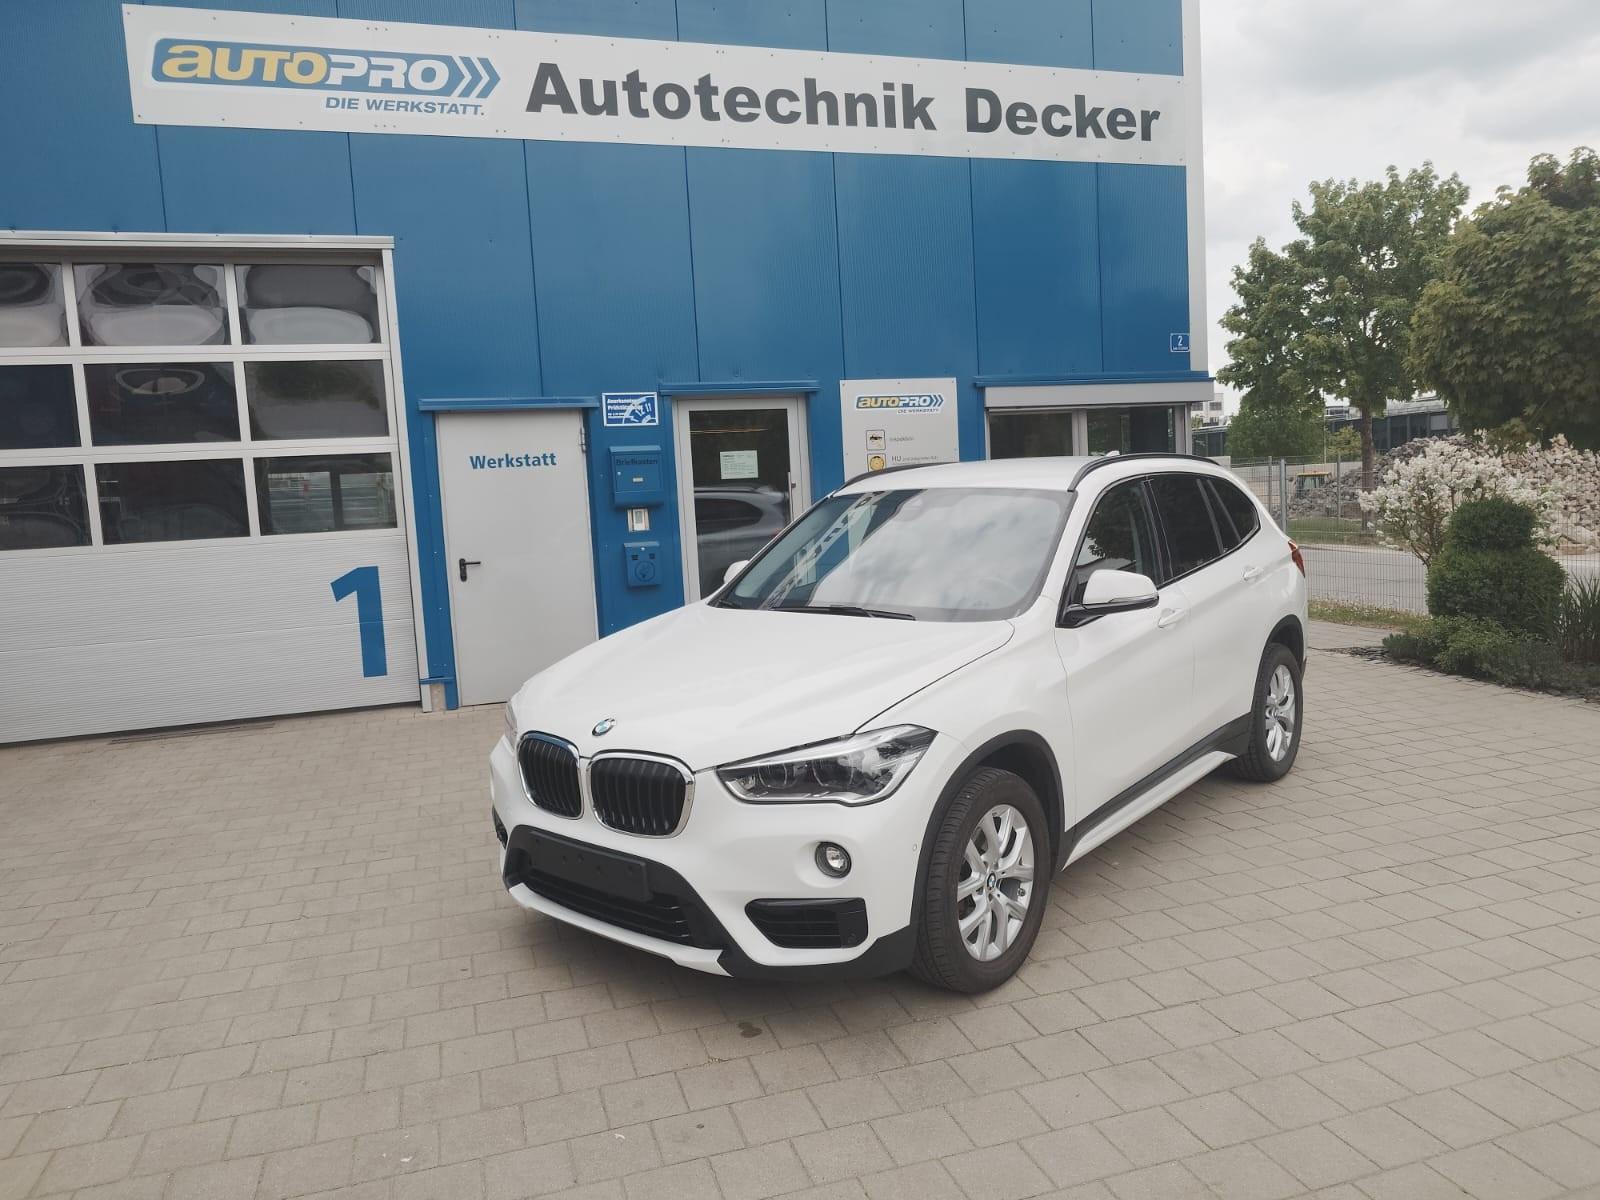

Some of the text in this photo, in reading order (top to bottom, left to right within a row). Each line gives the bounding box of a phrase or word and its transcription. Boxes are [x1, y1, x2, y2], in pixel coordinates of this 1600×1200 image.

[325, 96, 358, 110] DIE
[525, 62, 1161, 142] Autotechnik Decker
[1178, 335, 1183, 346] 2
[469, 453, 557, 469] Werkstatt
[330, 565, 388, 678] 1
